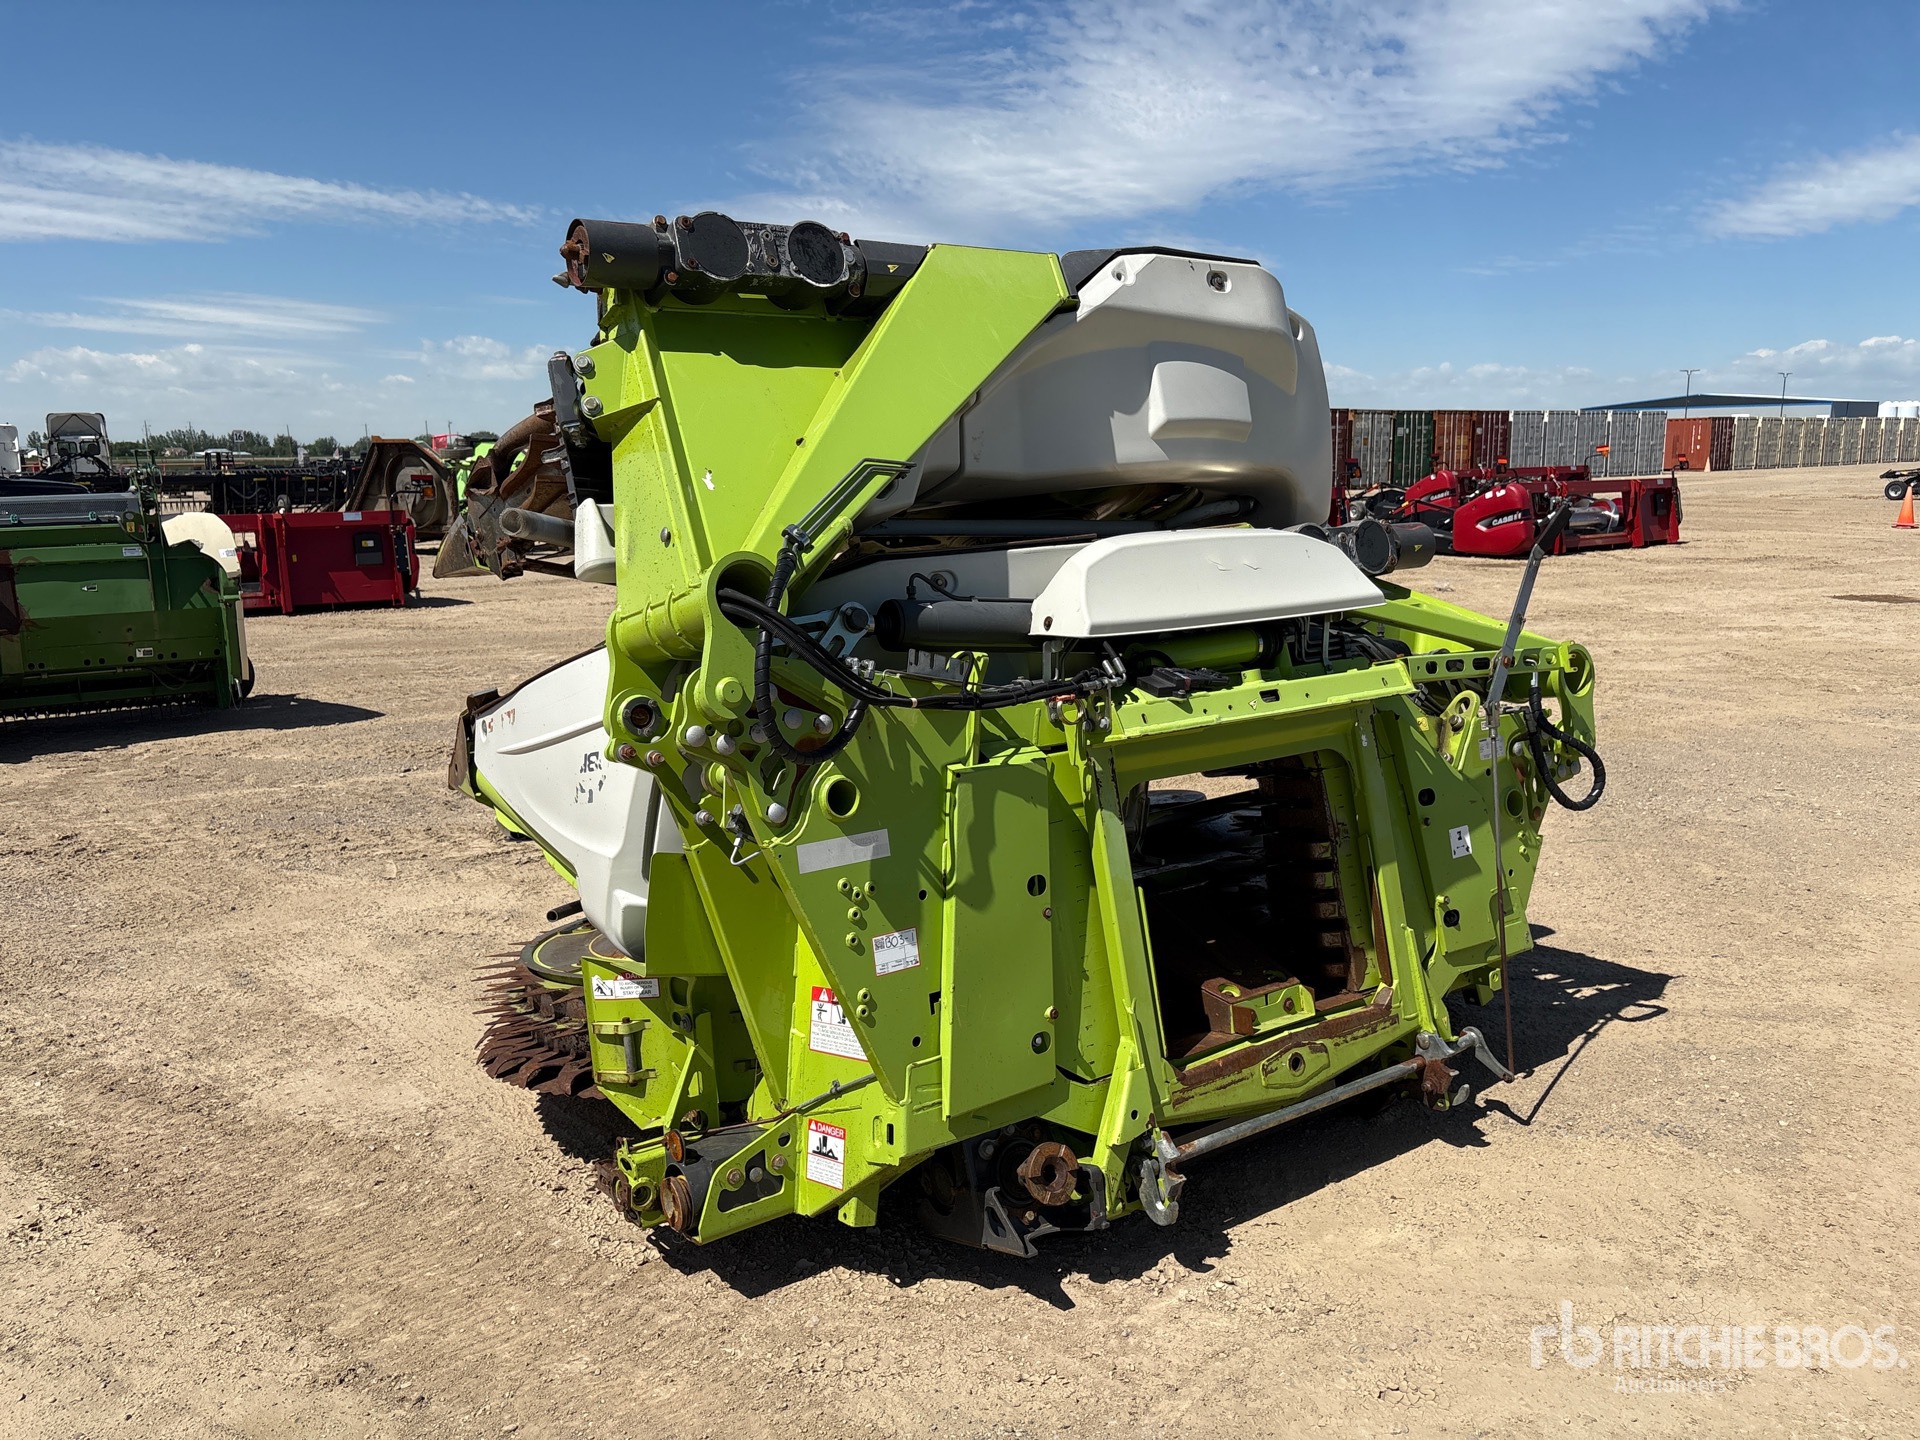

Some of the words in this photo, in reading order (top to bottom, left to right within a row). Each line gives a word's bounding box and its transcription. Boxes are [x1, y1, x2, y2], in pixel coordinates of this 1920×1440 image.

[234, 433, 244, 441] 16
[1492, 514, 1514, 526] CASE
[1513, 511, 1522, 521] IH
[817, 1122, 844, 1139] DANGER
